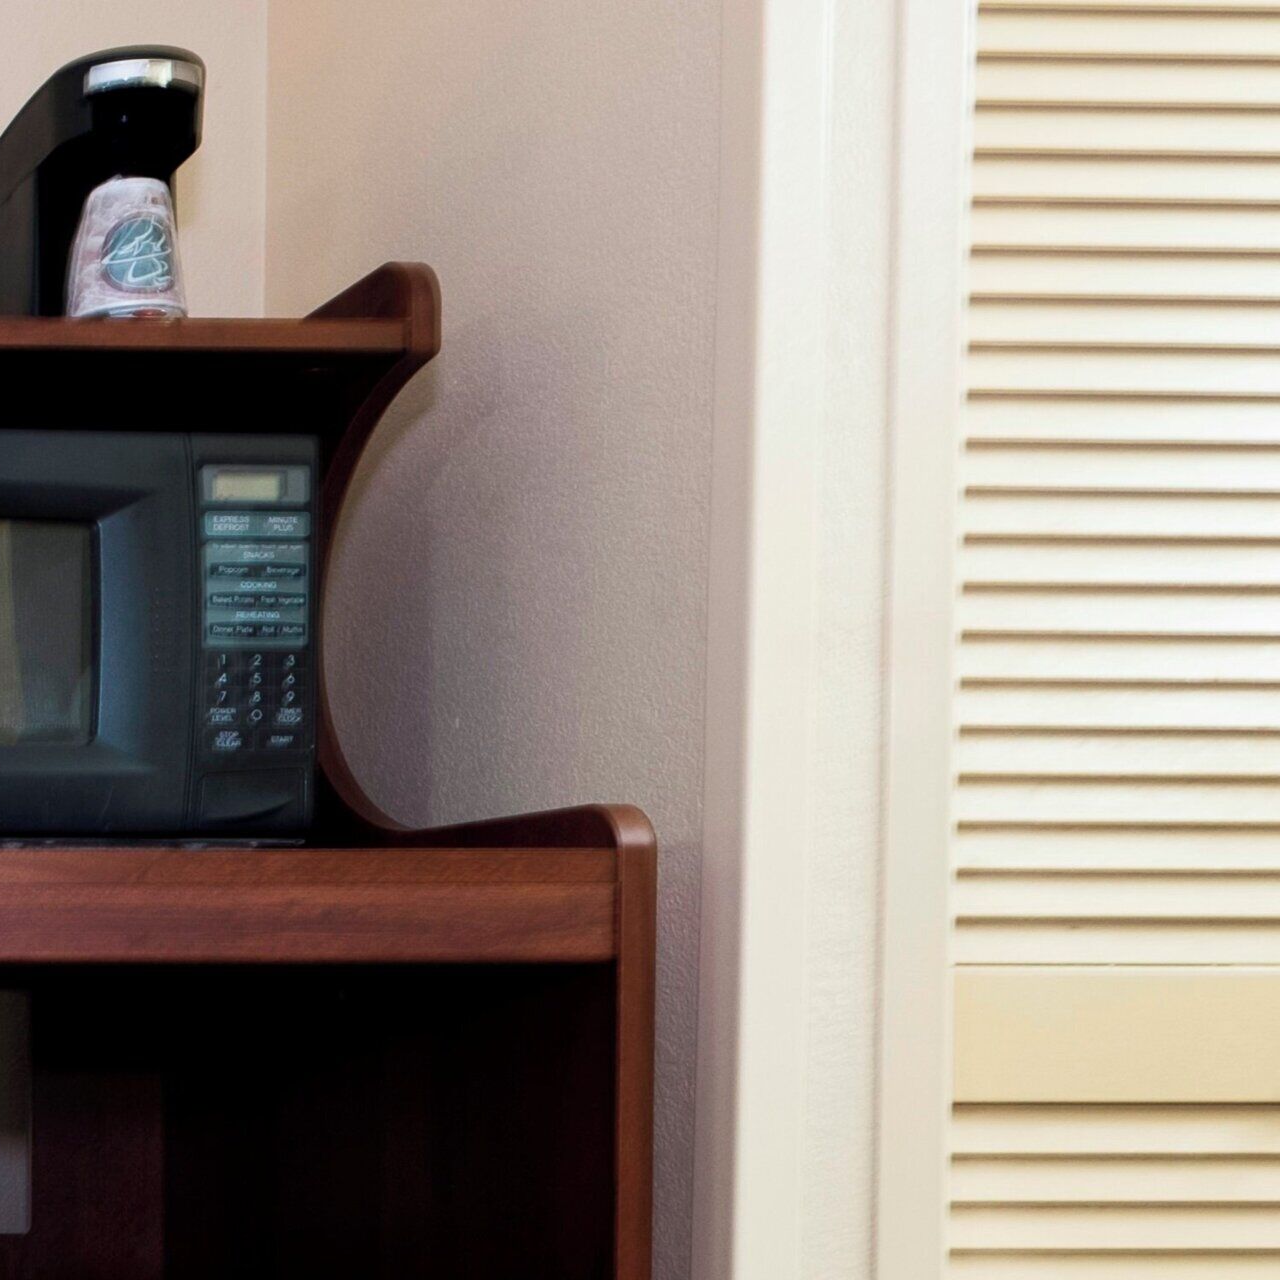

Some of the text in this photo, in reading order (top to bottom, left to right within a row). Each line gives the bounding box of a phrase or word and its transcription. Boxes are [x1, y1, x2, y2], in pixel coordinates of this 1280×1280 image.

[213, 515, 250, 523] EXPRESS
[213, 523, 250, 531] DEFROST
[240, 581, 277, 589] COOKING
[236, 610, 280, 619] REHEATING
[221, 653, 295, 666] 1 2 3
[219, 672, 295, 685] 4 5 6
[219, 690, 295, 703] 7 8 9
